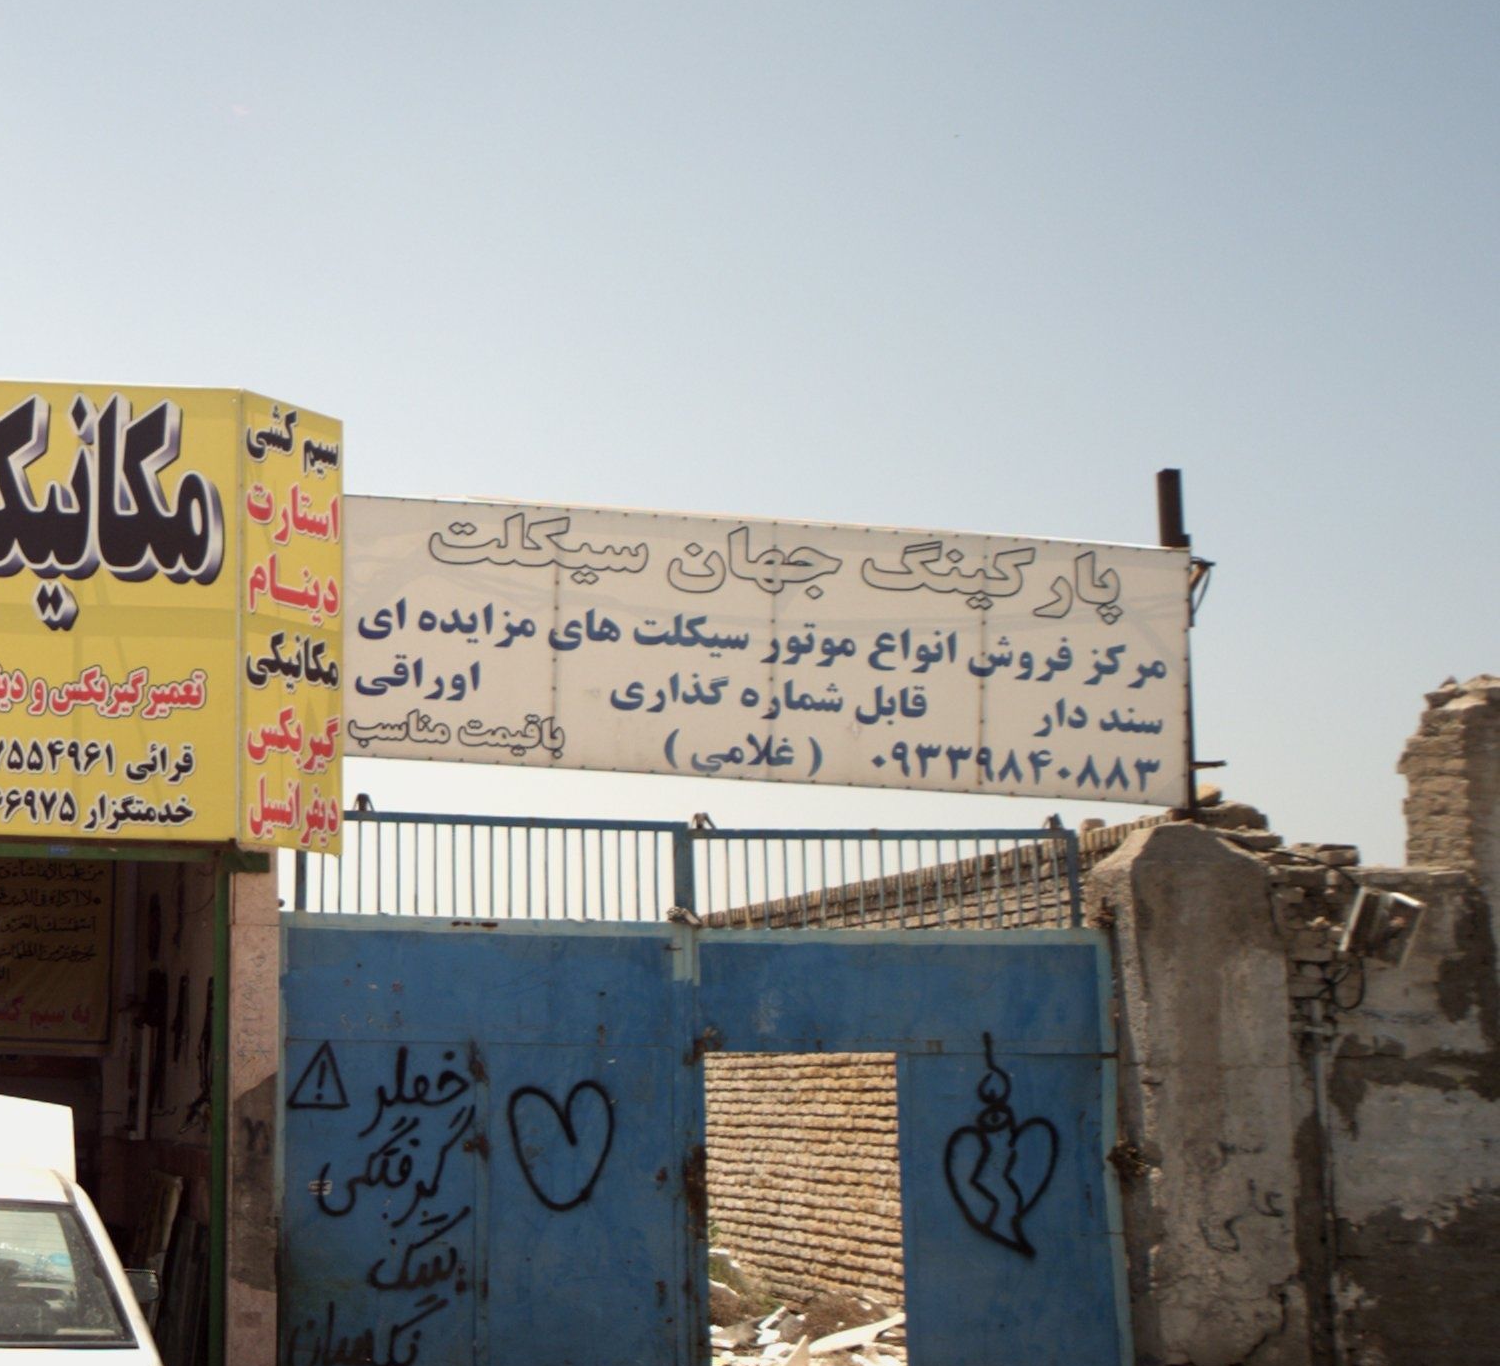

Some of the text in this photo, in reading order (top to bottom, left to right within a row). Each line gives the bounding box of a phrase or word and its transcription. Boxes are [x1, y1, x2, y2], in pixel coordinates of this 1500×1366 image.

[246, 406, 339, 475] سیم کشی
[246, 482, 339, 545] استارت
[429, 513, 1123, 624] پارکینگ جهان سیکلت
[246, 632, 338, 689] مکانیکی
[358, 598, 1167, 687] مرکز فروش انواع موتور سیکلت های مزایده ای
[28, 678, 48, 713] و
[50, 666, 148, 716] گیربکس
[142, 669, 207, 718] تعمیر
[355, 655, 480, 701] اوراقی
[611, 673, 729, 712] گذاری
[740, 680, 843, 719] شماره
[347, 709, 451, 748] مناسب
[856, 686, 927, 725] قابل
[126, 743, 194, 782] قرائی
[247, 705, 338, 772] گیربکس
[83, 794, 193, 834] خدمتگزار
[248, 776, 338, 845] دیفرانسیل
[358, 1046, 470, 1139] خطر
